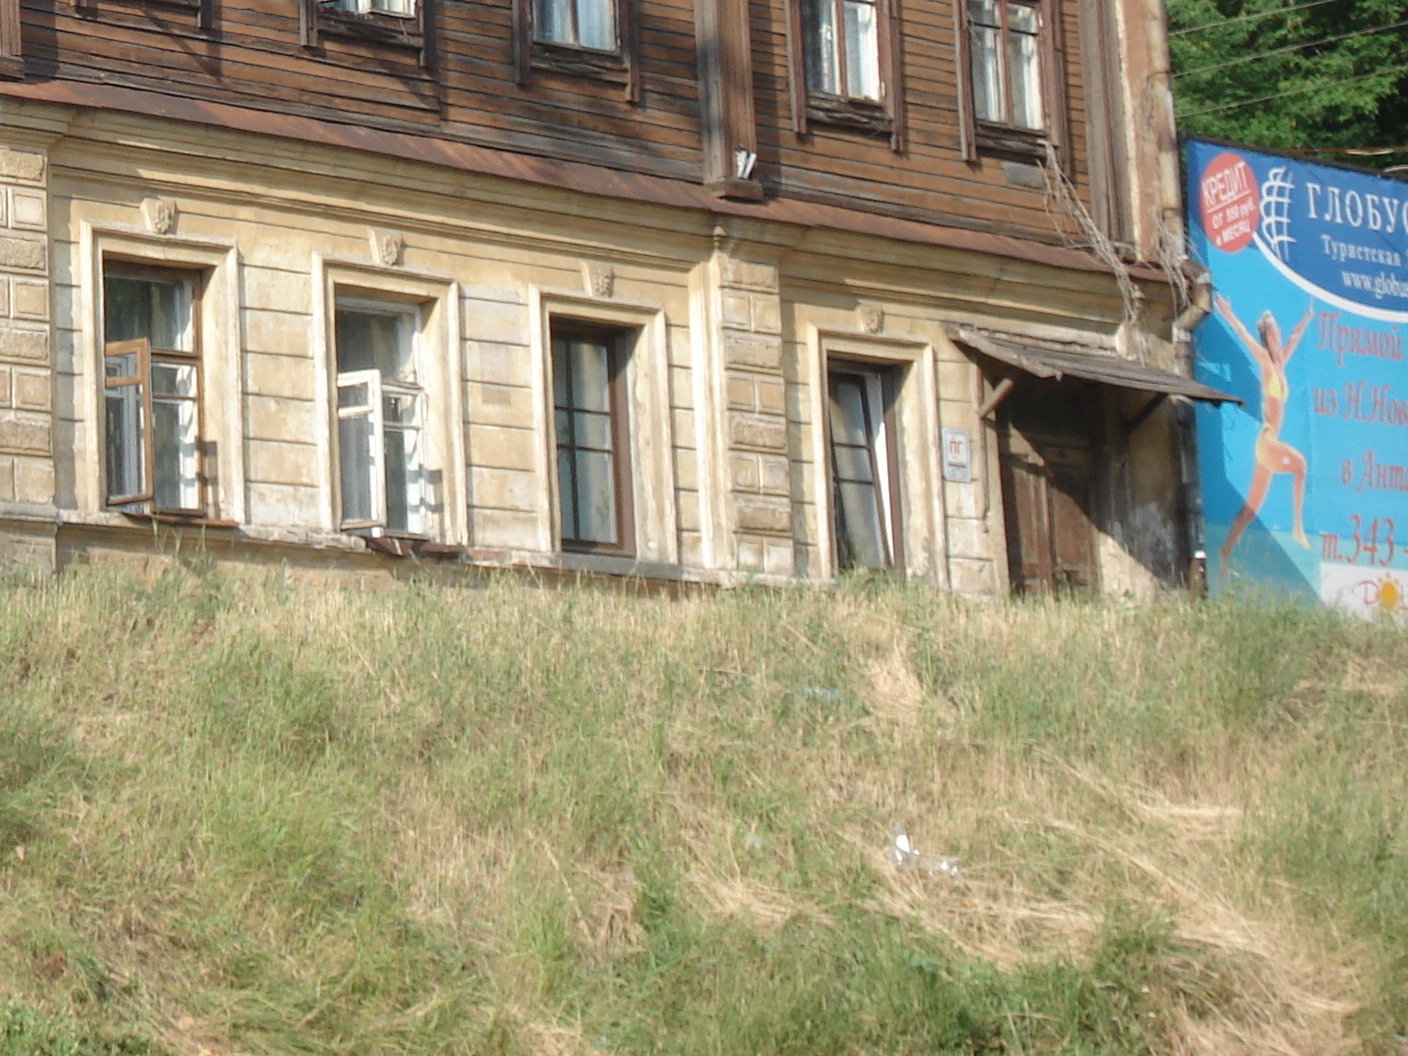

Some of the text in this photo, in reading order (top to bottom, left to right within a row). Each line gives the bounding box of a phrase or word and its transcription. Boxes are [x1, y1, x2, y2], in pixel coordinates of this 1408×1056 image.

[1202, 160, 1249, 209] КРЕДИТ
[1317, 312, 1403, 366] Прямой
[1314, 387, 1338, 417] из
[1355, 449, 1408, 493] Ант
